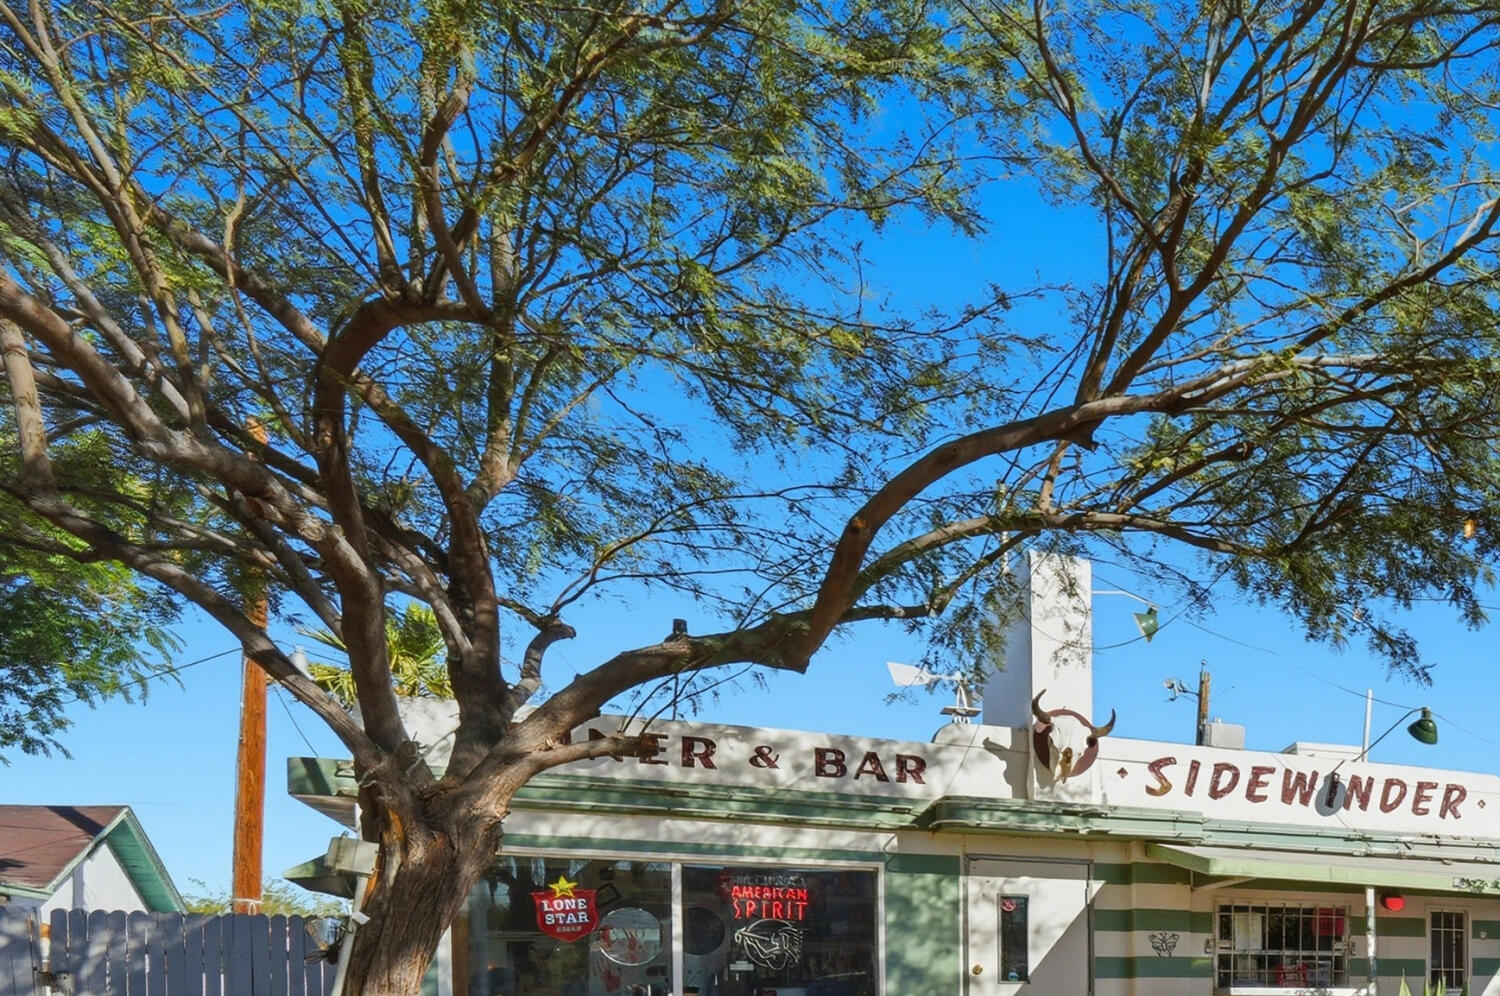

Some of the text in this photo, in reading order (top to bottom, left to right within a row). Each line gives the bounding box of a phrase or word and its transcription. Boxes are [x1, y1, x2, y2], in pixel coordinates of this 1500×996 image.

[748, 745, 781, 769] &
[814, 747, 927, 785] BAR
[1145, 757, 1467, 820] SIDEWINDER
[731, 885, 808, 900] AMERICAN
[541, 898, 588, 912] LONE
[732, 900, 808, 920] SPIRIT
[545, 911, 590, 925] STAR
